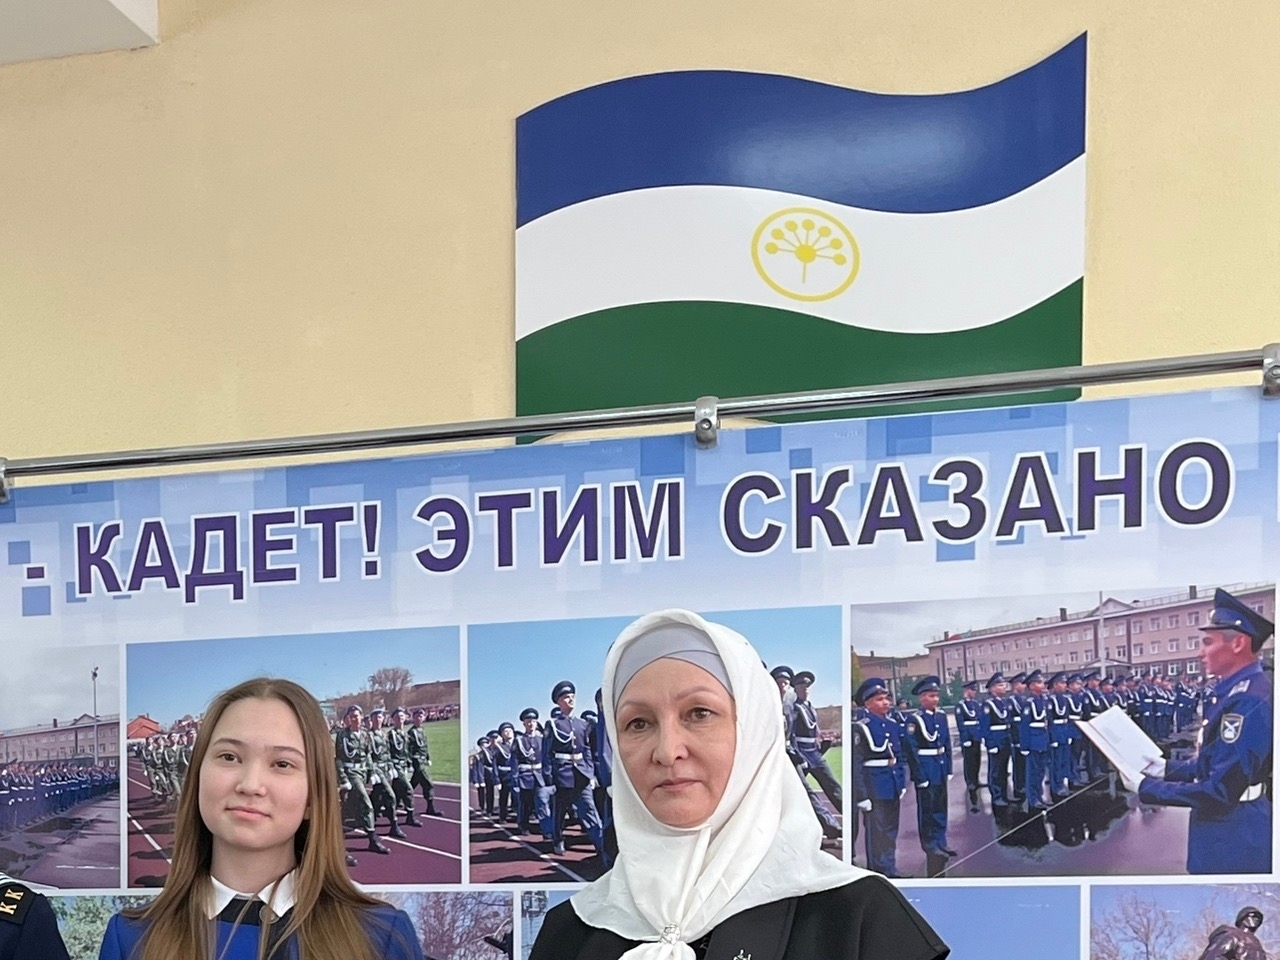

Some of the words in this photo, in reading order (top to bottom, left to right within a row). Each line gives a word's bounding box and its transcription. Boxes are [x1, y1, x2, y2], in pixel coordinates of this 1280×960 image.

[25, 564, 46, 580] -
[75, 501, 382, 604] КАДЕТ!
[413, 476, 684, 574] ЭТИМ
[721, 439, 1234, 555] СКАЗАНО
